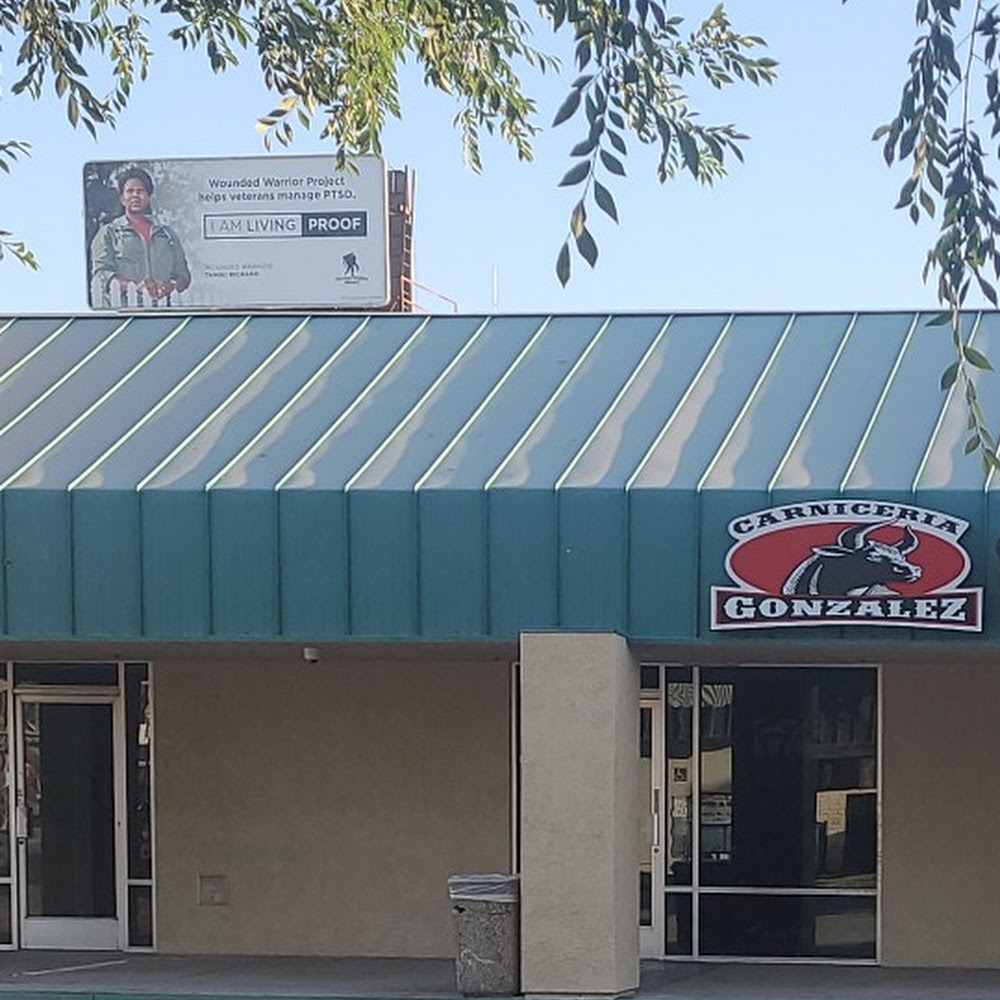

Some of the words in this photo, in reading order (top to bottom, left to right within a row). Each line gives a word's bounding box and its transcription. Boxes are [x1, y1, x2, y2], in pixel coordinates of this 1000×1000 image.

[209, 177, 260, 189] Wounded
[263, 176, 304, 188] Warrior
[307, 175, 346, 188] Project
[198, 191, 227, 204] helps
[229, 191, 275, 201] veterans
[277, 191, 321, 202] manage
[220, 220, 242, 232] AM
[247, 219, 297, 232] LIVING
[308, 217, 362, 231] PROOF
[732, 500, 964, 538] CARNICERIA
[722, 594, 968, 624] GONZALEZ
